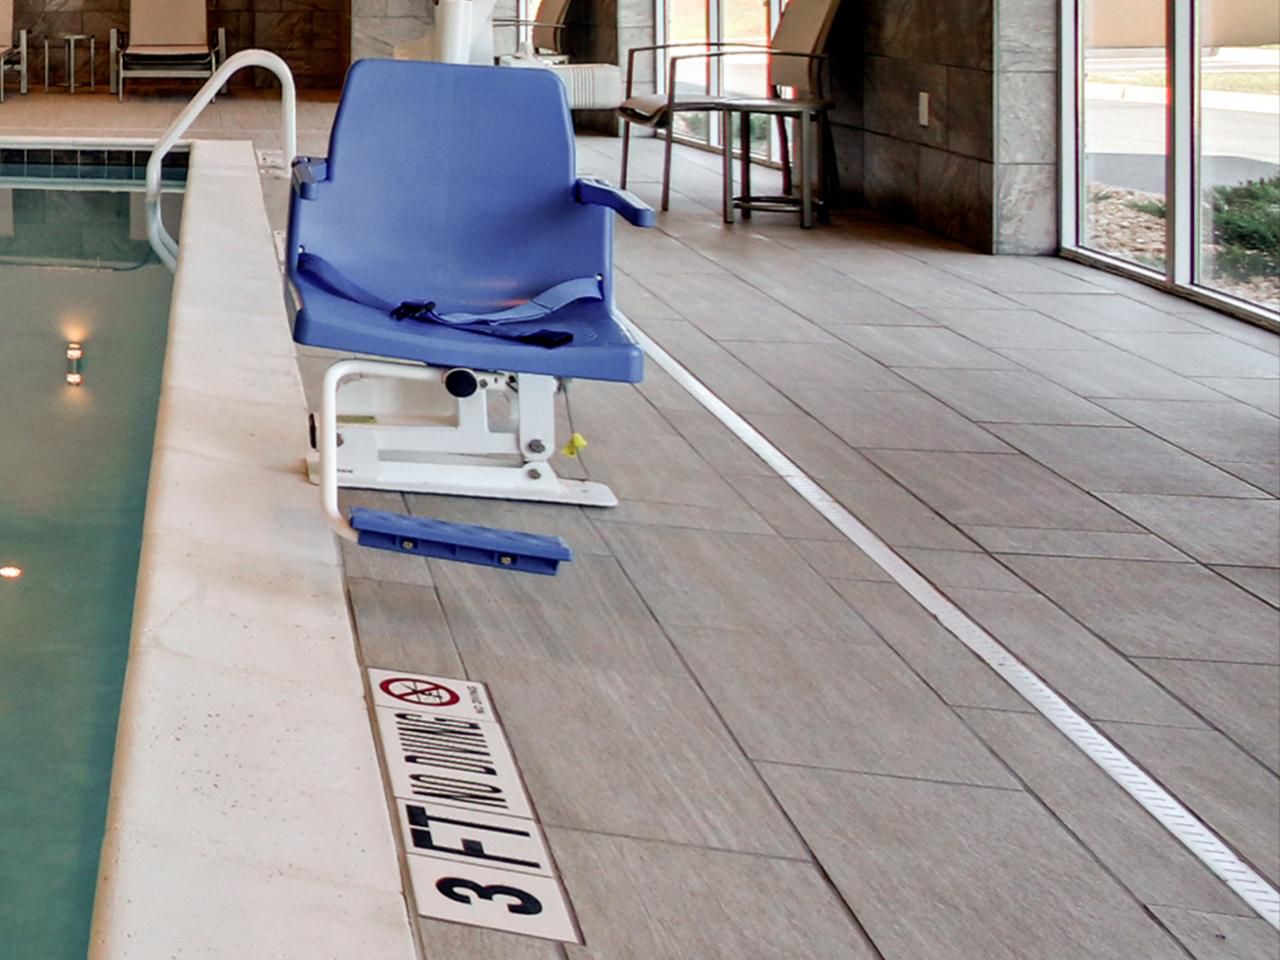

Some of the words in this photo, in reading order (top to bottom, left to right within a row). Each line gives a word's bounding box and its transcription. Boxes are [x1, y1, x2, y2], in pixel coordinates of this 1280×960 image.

[394, 712, 497, 777] DIVING
[409, 773, 509, 810] NO
[405, 804, 542, 869] FT
[435, 876, 543, 917] 3
